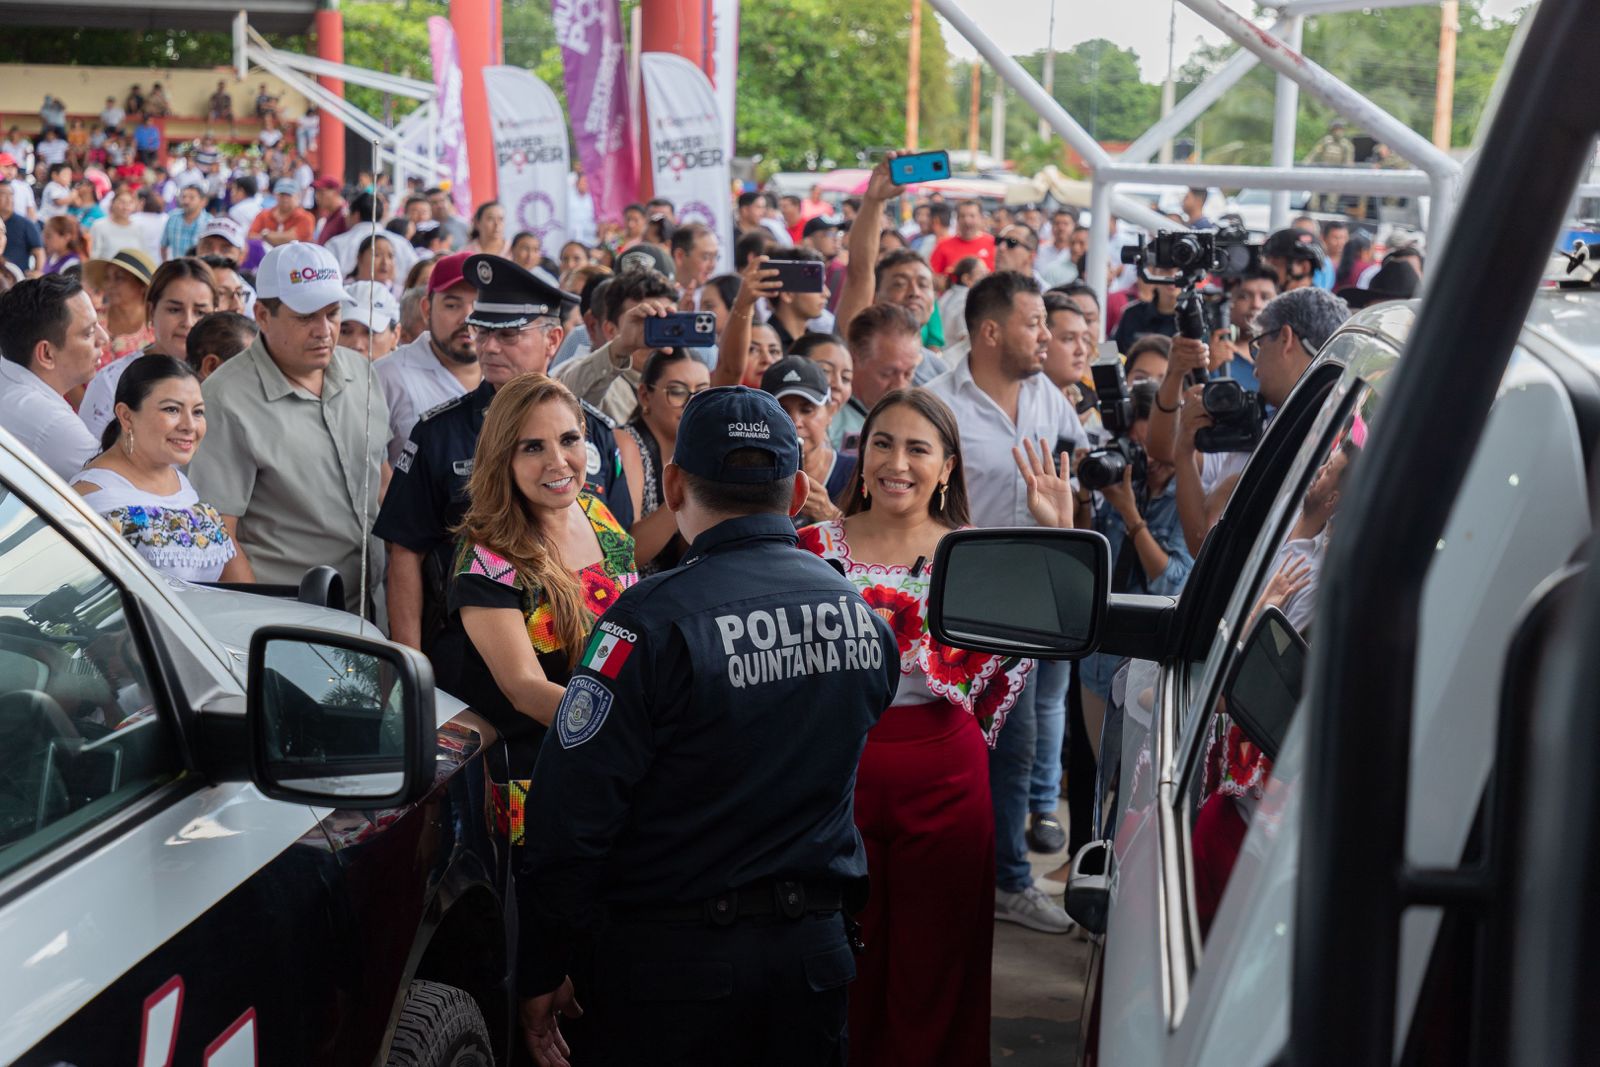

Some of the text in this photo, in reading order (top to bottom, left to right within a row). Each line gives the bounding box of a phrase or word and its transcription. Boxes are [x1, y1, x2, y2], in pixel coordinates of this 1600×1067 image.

[499, 146, 563, 167] PODER
[657, 149, 723, 172] PODER
[728, 421, 770, 434] POLICÍA
[599, 620, 638, 643] MÉXICO
[715, 595, 879, 656] POLICÍA
[728, 638, 882, 689] QUINTANA ROO
